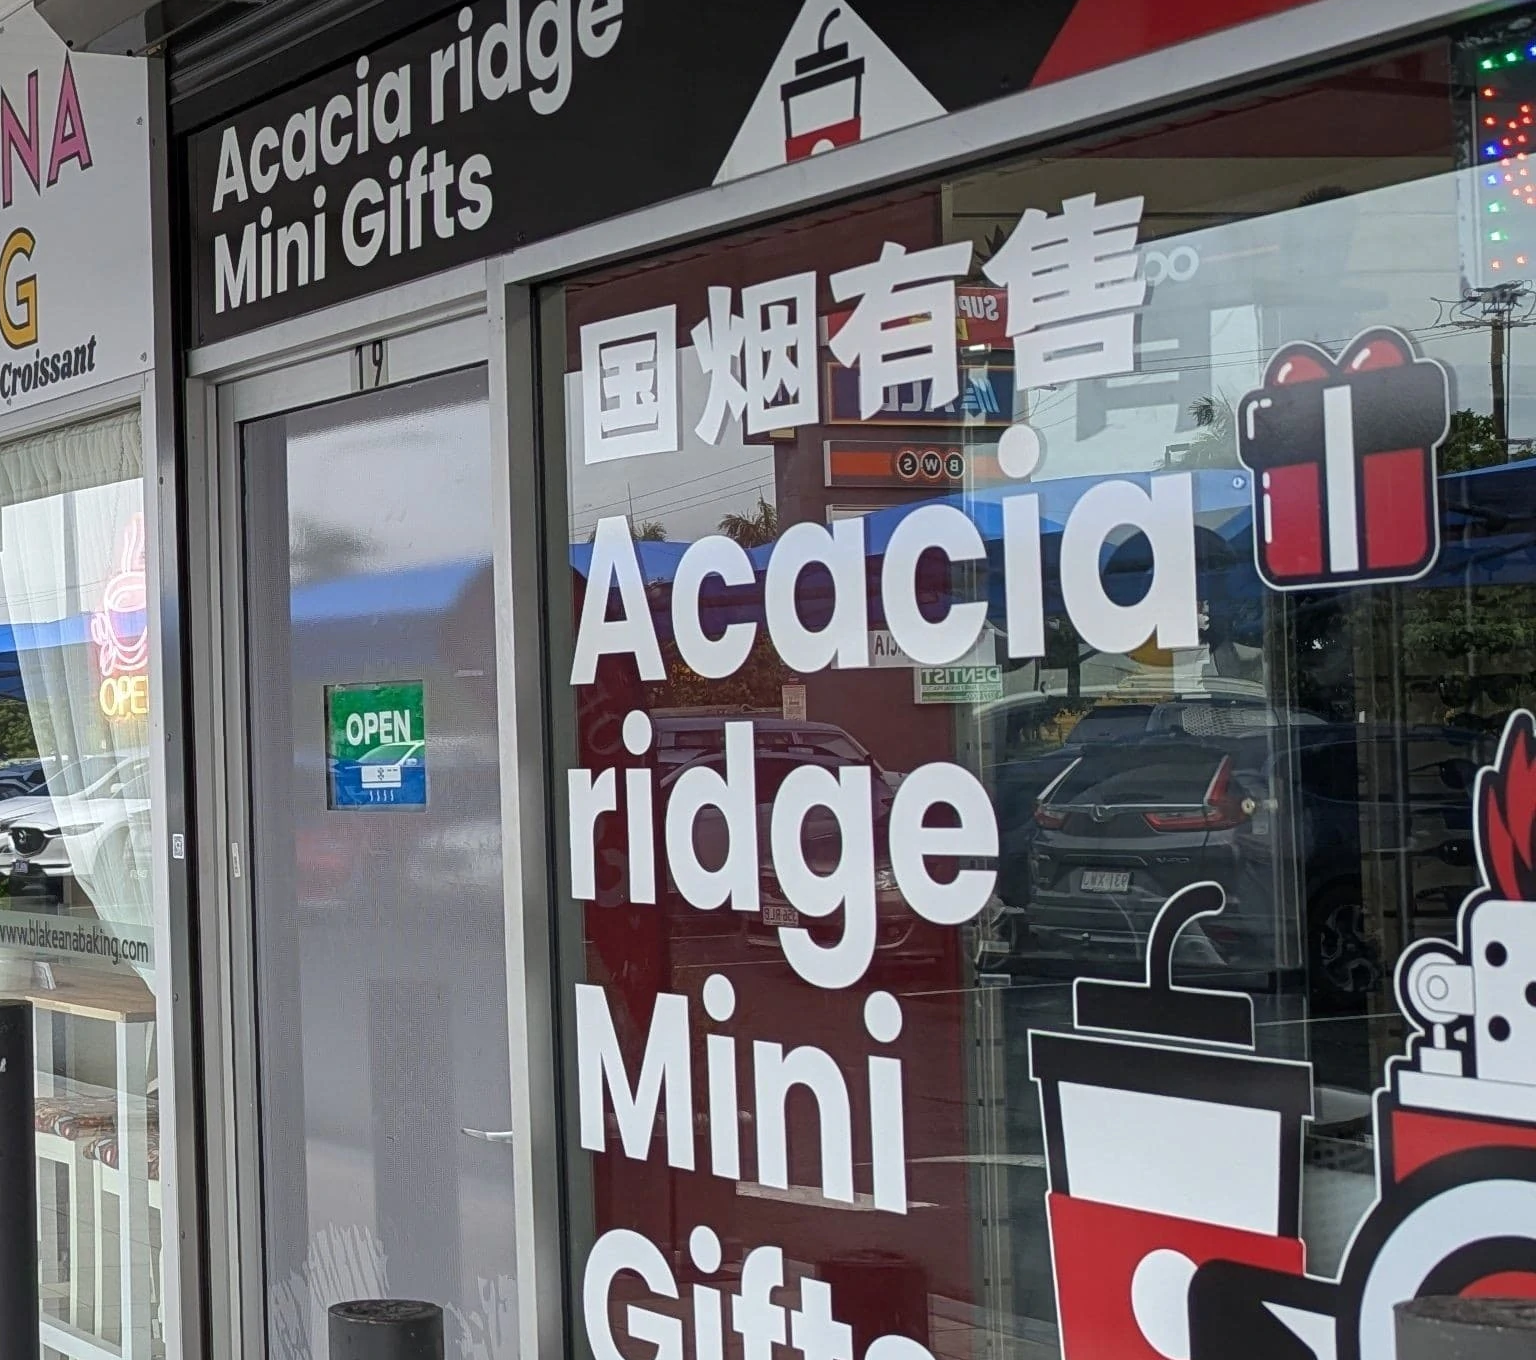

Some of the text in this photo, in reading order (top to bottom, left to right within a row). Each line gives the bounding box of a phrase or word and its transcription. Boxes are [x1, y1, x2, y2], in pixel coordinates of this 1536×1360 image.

[212, 55, 411, 212] Acacia
[215, 146, 493, 315] Mini Gifts
[0, 334, 96, 397] Croissant
[354, 340, 384, 390] 19
[580, 193, 1151, 465] 国烟有售
[570, 424, 1200, 686] Acacia
[99, 674, 149, 716] OPE
[345, 709, 411, 746] OPEN
[569, 709, 1000, 989] ridge
[575, 974, 908, 1215] Mini
